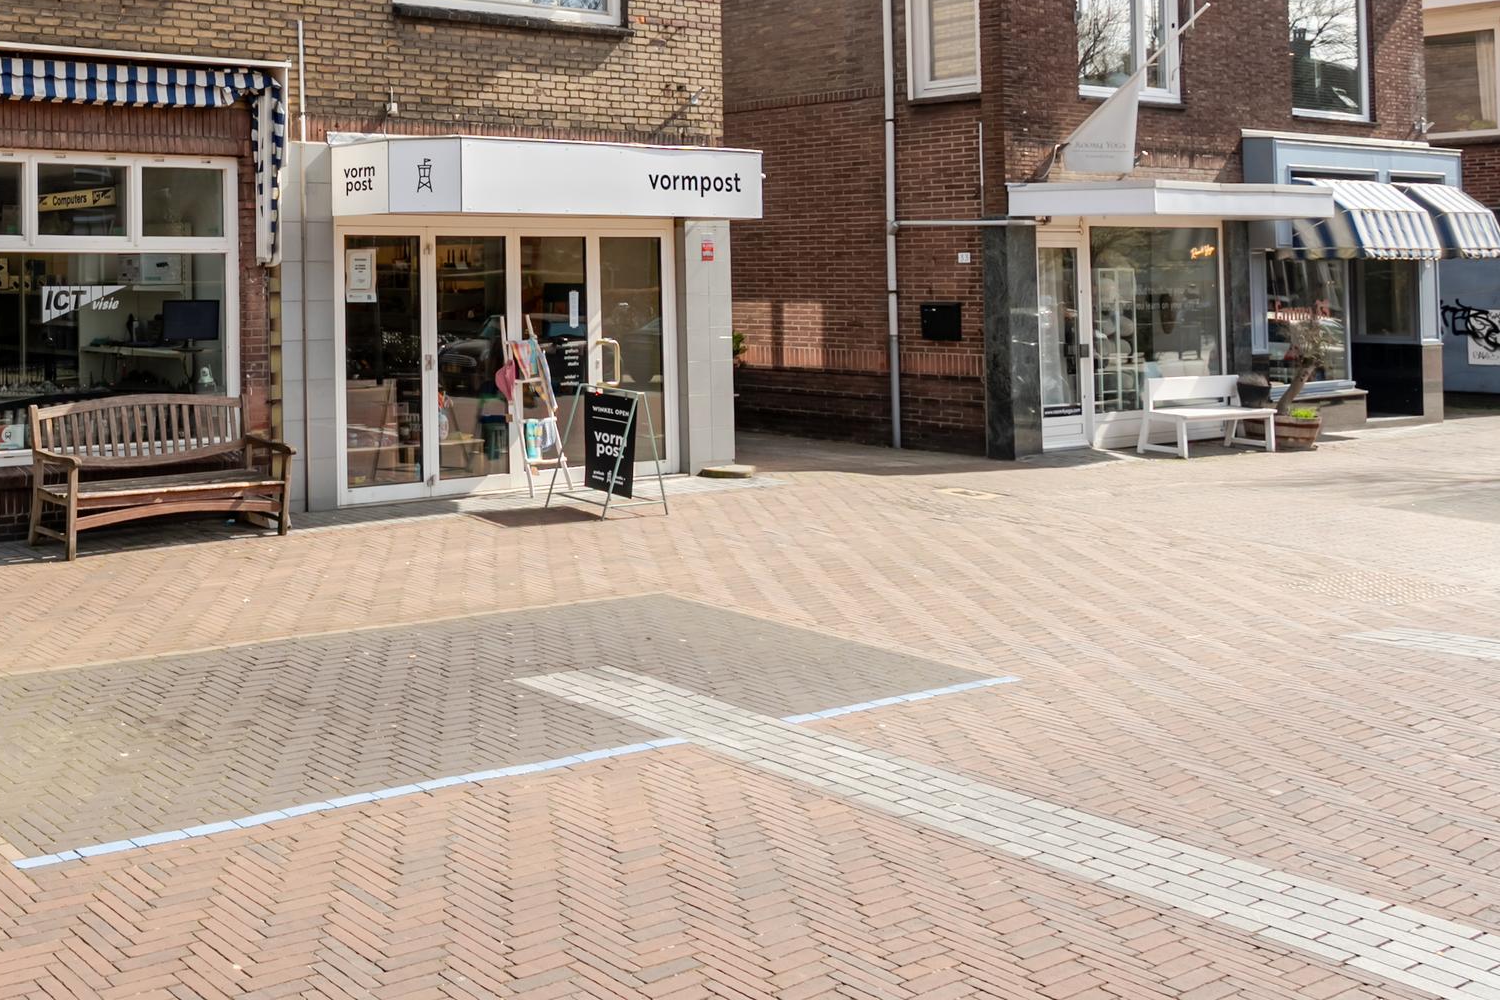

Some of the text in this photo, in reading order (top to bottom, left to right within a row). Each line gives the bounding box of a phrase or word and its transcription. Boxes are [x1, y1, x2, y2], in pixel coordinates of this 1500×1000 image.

[343, 165, 375, 178] vorm
[346, 177, 373, 196] post
[648, 172, 741, 198] vormpost
[52, 194, 88, 207] Computers
[45, 290, 87, 311] ICT
[592, 405, 630, 417] WINKEL OPEN
